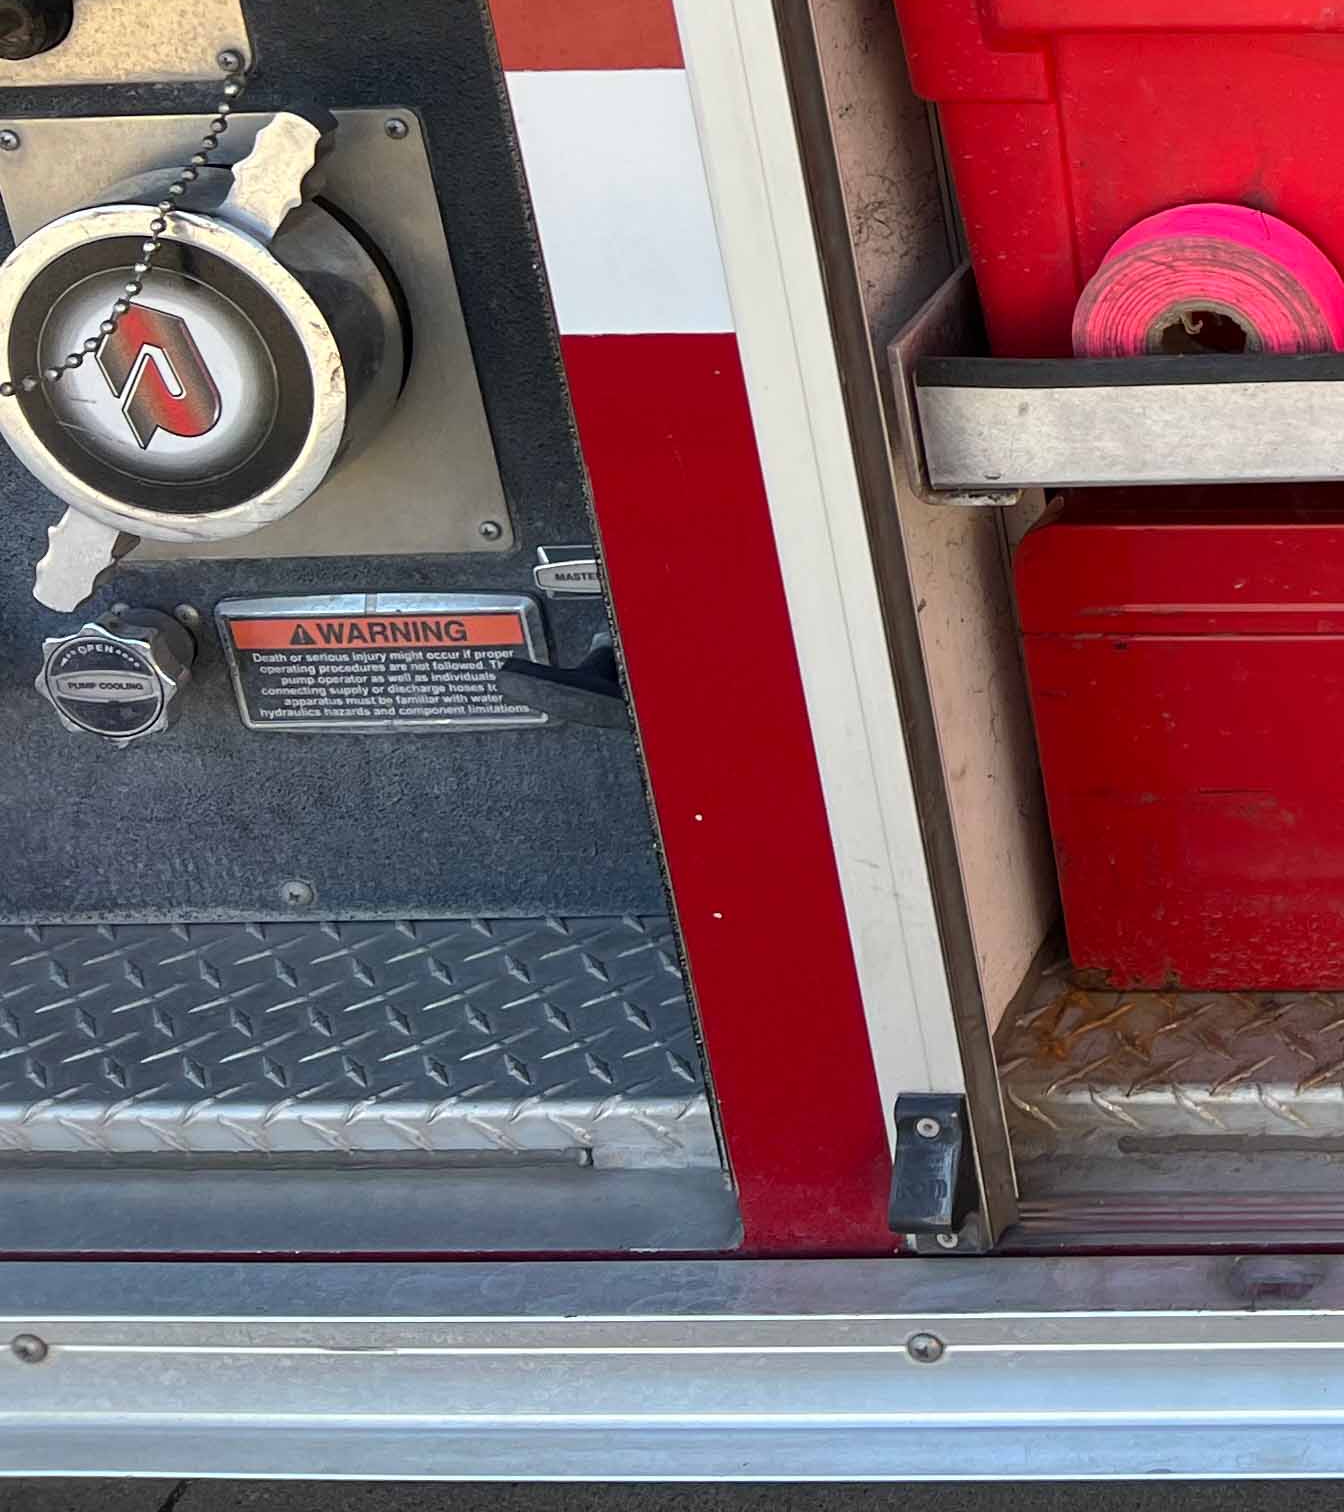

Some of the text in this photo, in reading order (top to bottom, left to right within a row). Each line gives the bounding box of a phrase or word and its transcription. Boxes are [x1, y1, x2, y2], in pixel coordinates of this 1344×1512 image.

[316, 620, 468, 645] WARNING
[77, 643, 115, 656] OPEN
[252, 649, 514, 664] Death or serious injury might occur if proper
[260, 663, 316, 675] operating
[319, 662, 386, 674] procedures
[389, 663, 408, 671] are
[411, 661, 431, 671] not
[99, 681, 144, 690] COOLING
[281, 671, 497, 686] pump operator as well as individuals
[260, 685, 327, 697] connecting
[329, 685, 369, 697] supply
[371, 686, 385, 694] or
[387, 683, 446, 695] discharge
[449, 683, 485, 692] hoses
[283, 693, 504, 707] apparatus must be familiar with water
[260, 707, 322, 719] hydraulics
[324, 706, 371, 716] hazards
[374, 706, 396, 716] and
[398, 705, 466, 717] component
